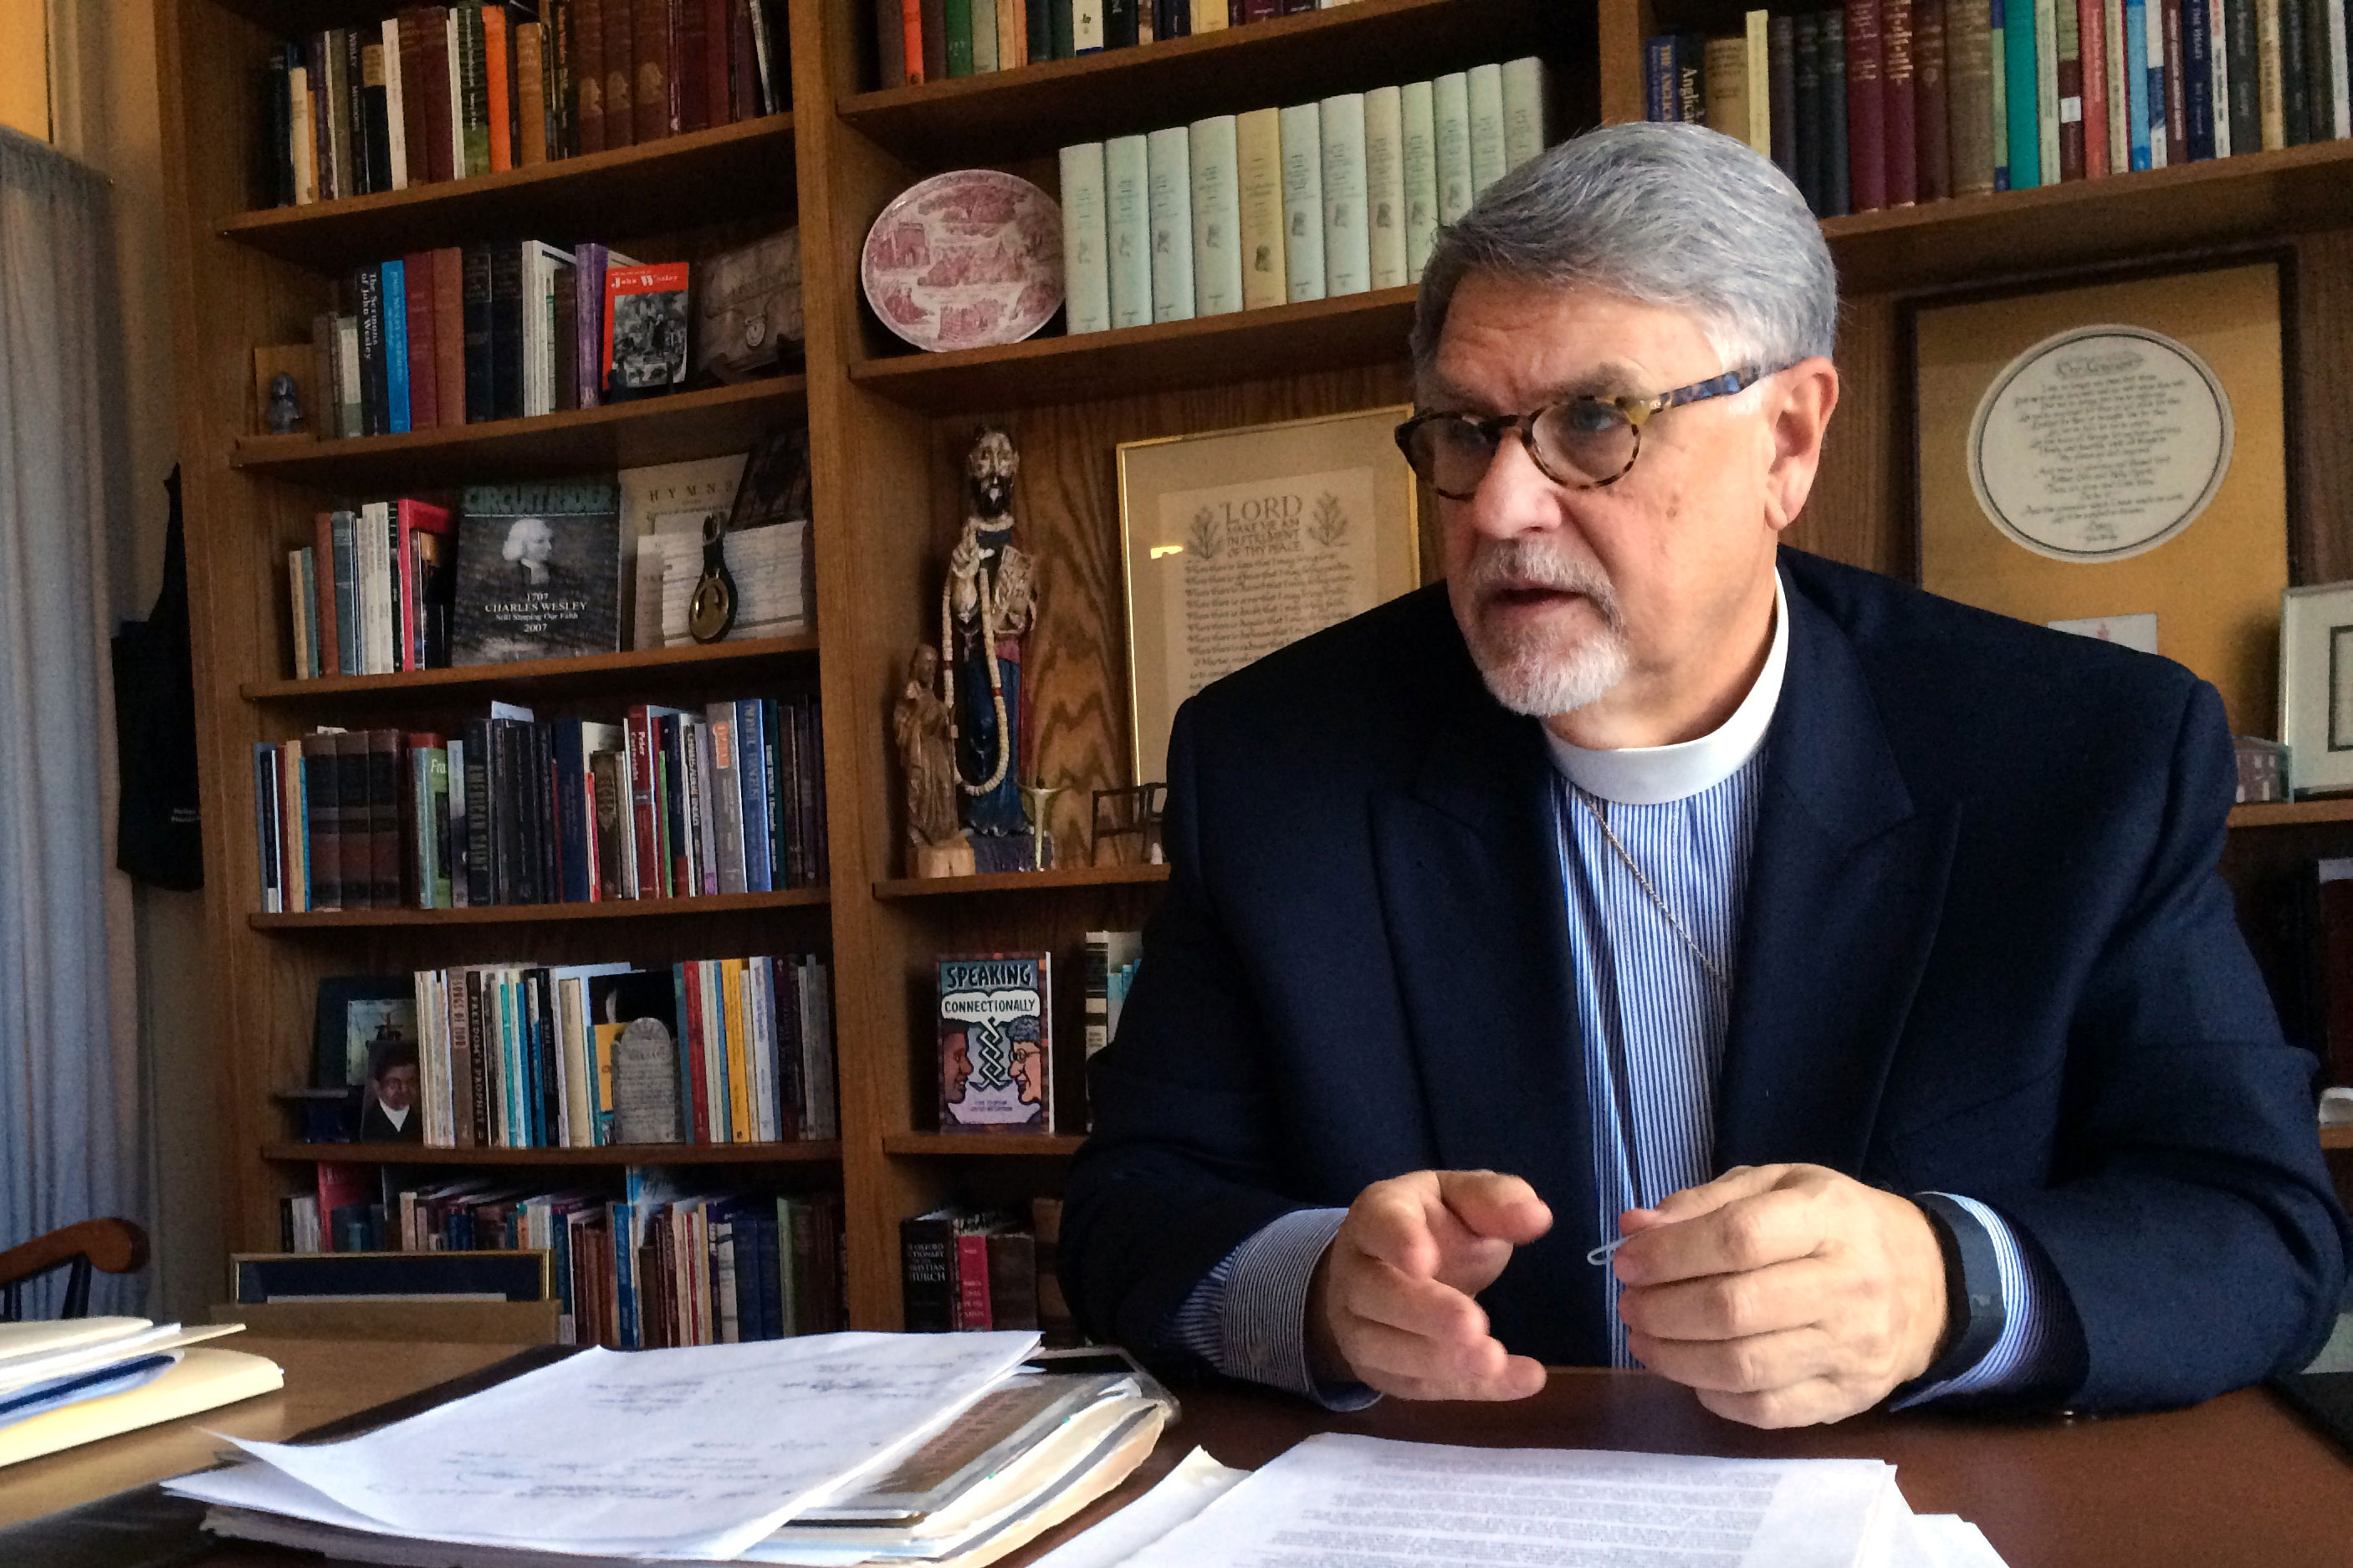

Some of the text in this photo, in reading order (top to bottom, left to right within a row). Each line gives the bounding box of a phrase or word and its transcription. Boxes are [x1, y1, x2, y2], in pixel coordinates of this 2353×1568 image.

[349, 31, 359, 68] WESLEY
[1661, 72, 1673, 122] ANGLICA
[611, 273, 678, 289] John Wesley
[360, 273, 372, 360] of John Wesley
[368, 272, 379, 345] The Sermons
[1219, 494, 1303, 525] LORD
[485, 600, 588, 613] CHARLES WESLEY
[527, 592, 549, 602] 1707
[495, 610, 579, 622] Still Shaping Our Faith
[524, 622, 549, 633] 2007
[637, 730, 647, 756] Peter
[946, 963, 1033, 988] SPEAKING
[452, 981, 465, 1009] SONGS
[944, 998, 1036, 1014] CONNECTIONALLY
[469, 996, 485, 1124] FREEDOM'S PROPHET
[909, 1271, 947, 1282] HURCH
